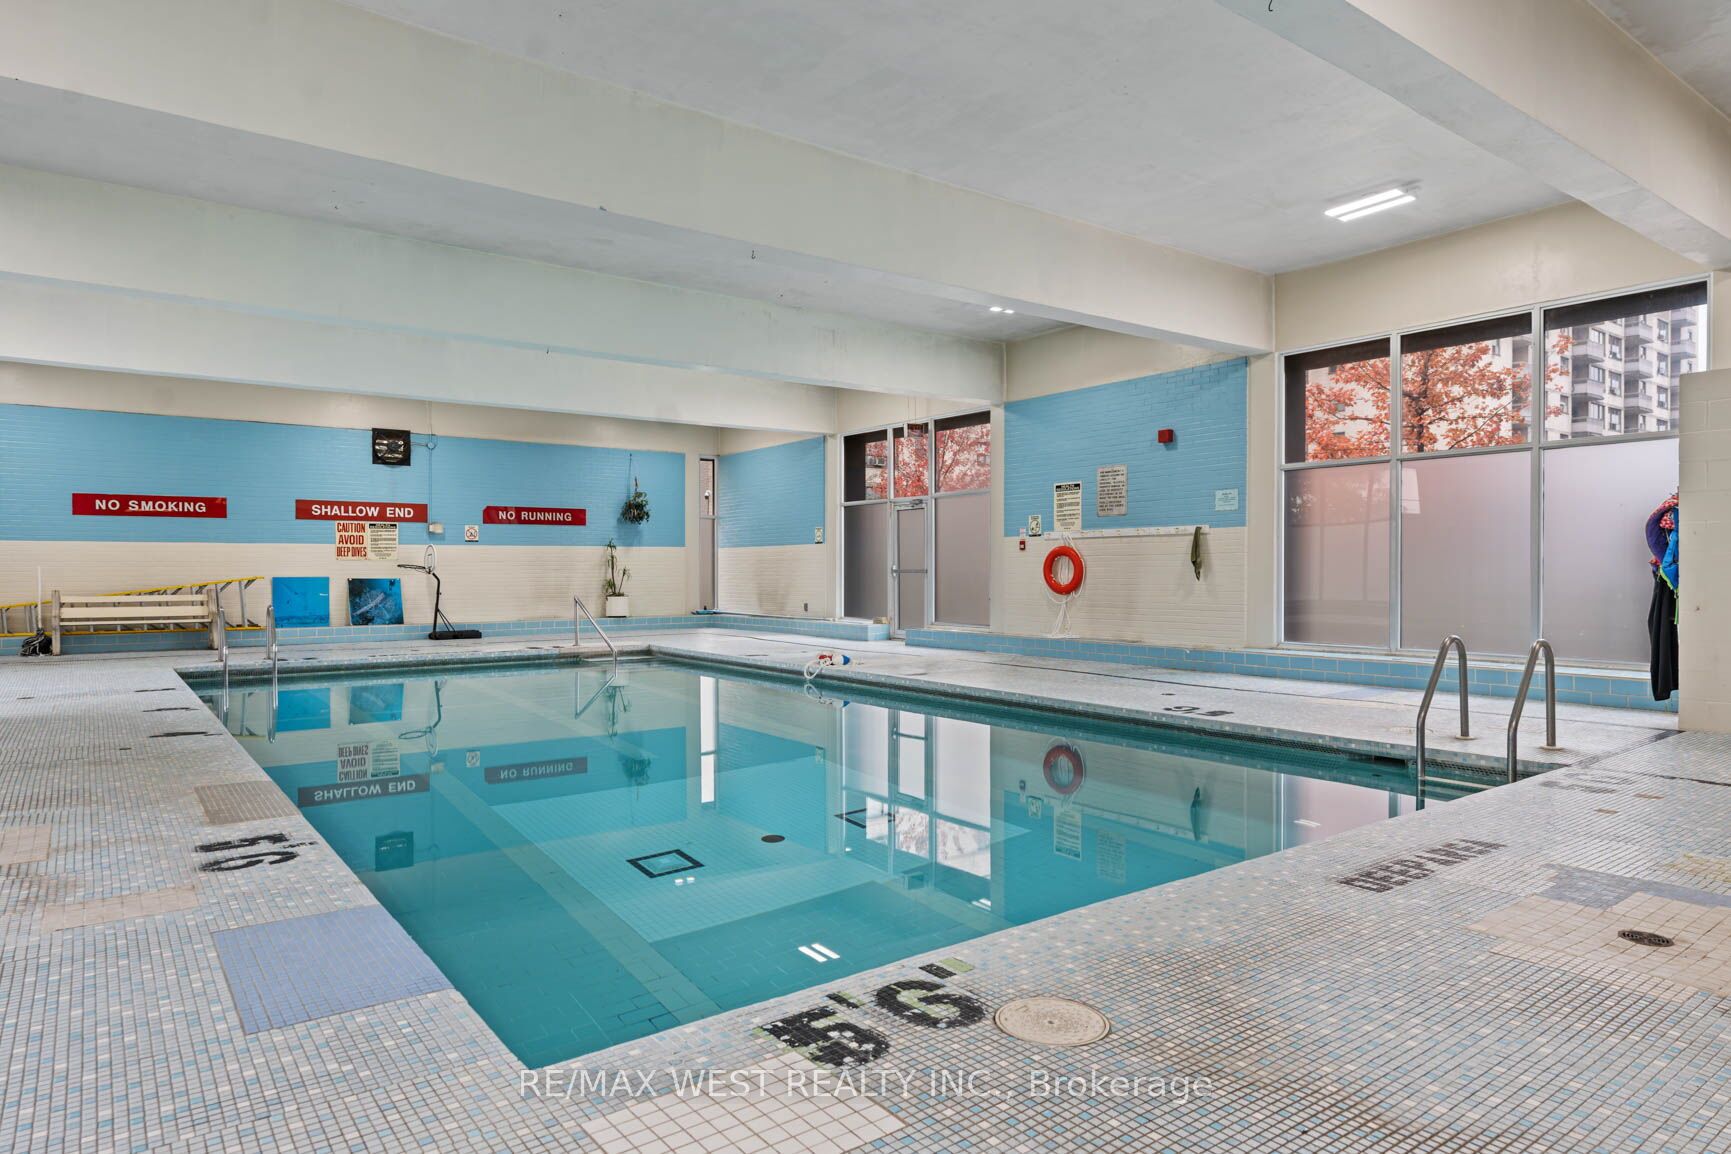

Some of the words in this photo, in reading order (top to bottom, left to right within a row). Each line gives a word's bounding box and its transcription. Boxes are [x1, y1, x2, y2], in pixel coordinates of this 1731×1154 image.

[95, 499, 120, 511] NO
[128, 500, 207, 513] SMOKING
[311, 504, 379, 517] SHALLOW
[386, 507, 414, 518] END
[498, 511, 516, 520] NO
[521, 511, 572, 521] RUNNING
[337, 522, 365, 533] CAUTION
[338, 534, 364, 545] AVOID
[336, 546, 350, 557] DEEP
[351, 547, 367, 558] DIVES
[1336, 859, 1435, 893] DEEP
